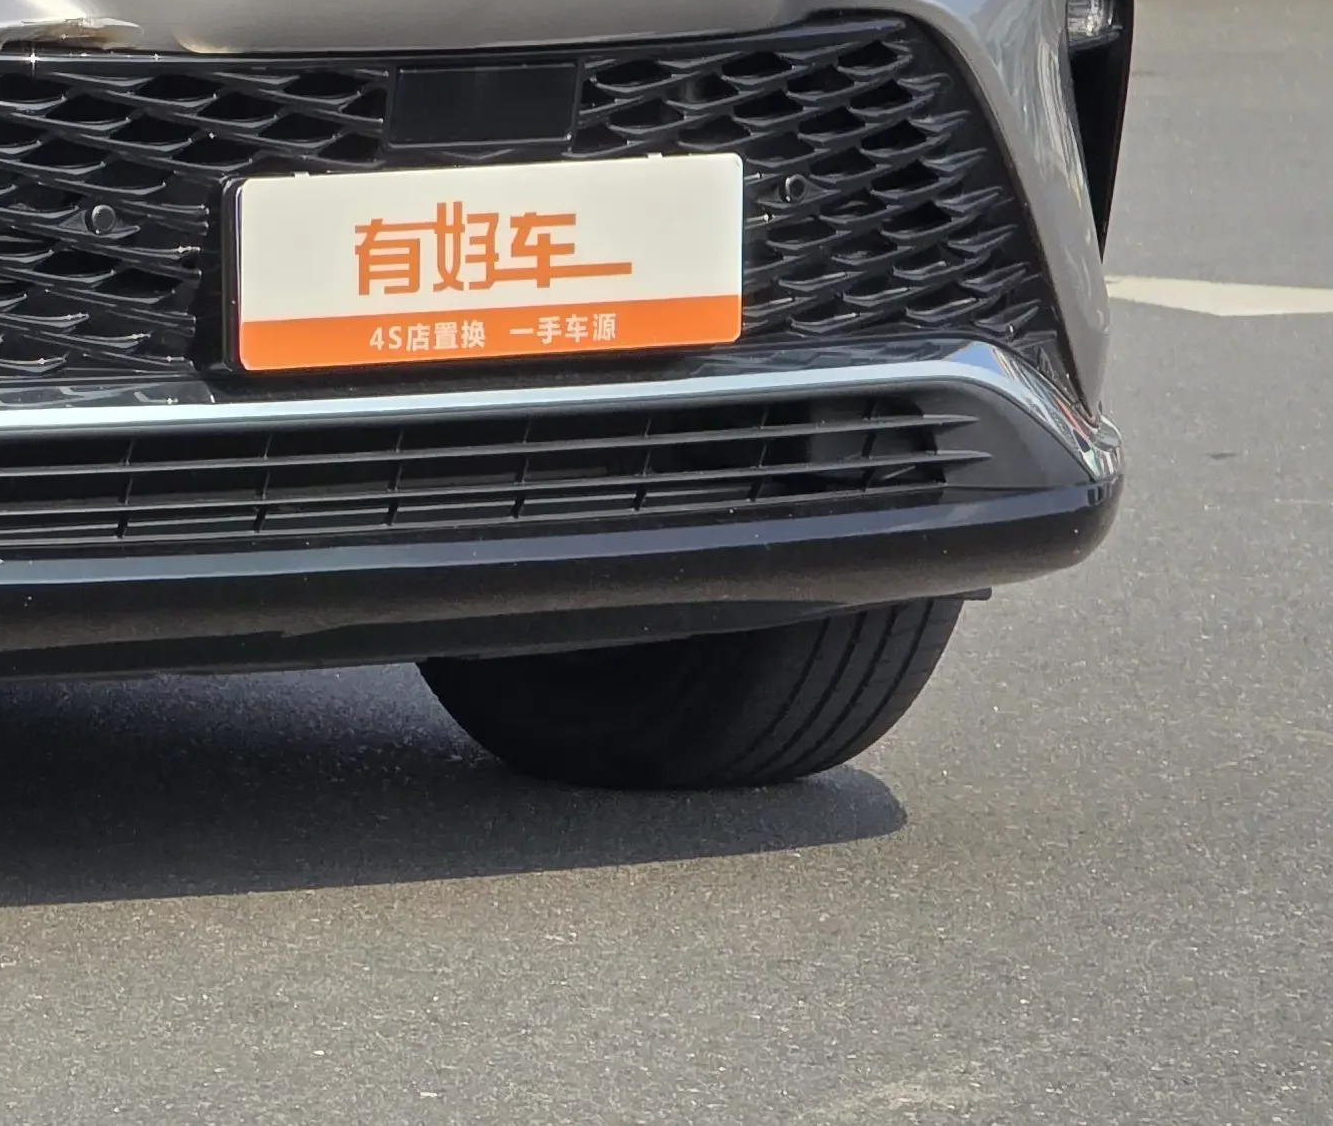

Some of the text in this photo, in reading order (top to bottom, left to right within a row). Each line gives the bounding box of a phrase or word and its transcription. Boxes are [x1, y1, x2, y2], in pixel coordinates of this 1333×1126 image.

[354, 200, 633, 296] 有好车
[369, 312, 617, 353] 4S店置换 一手车源
